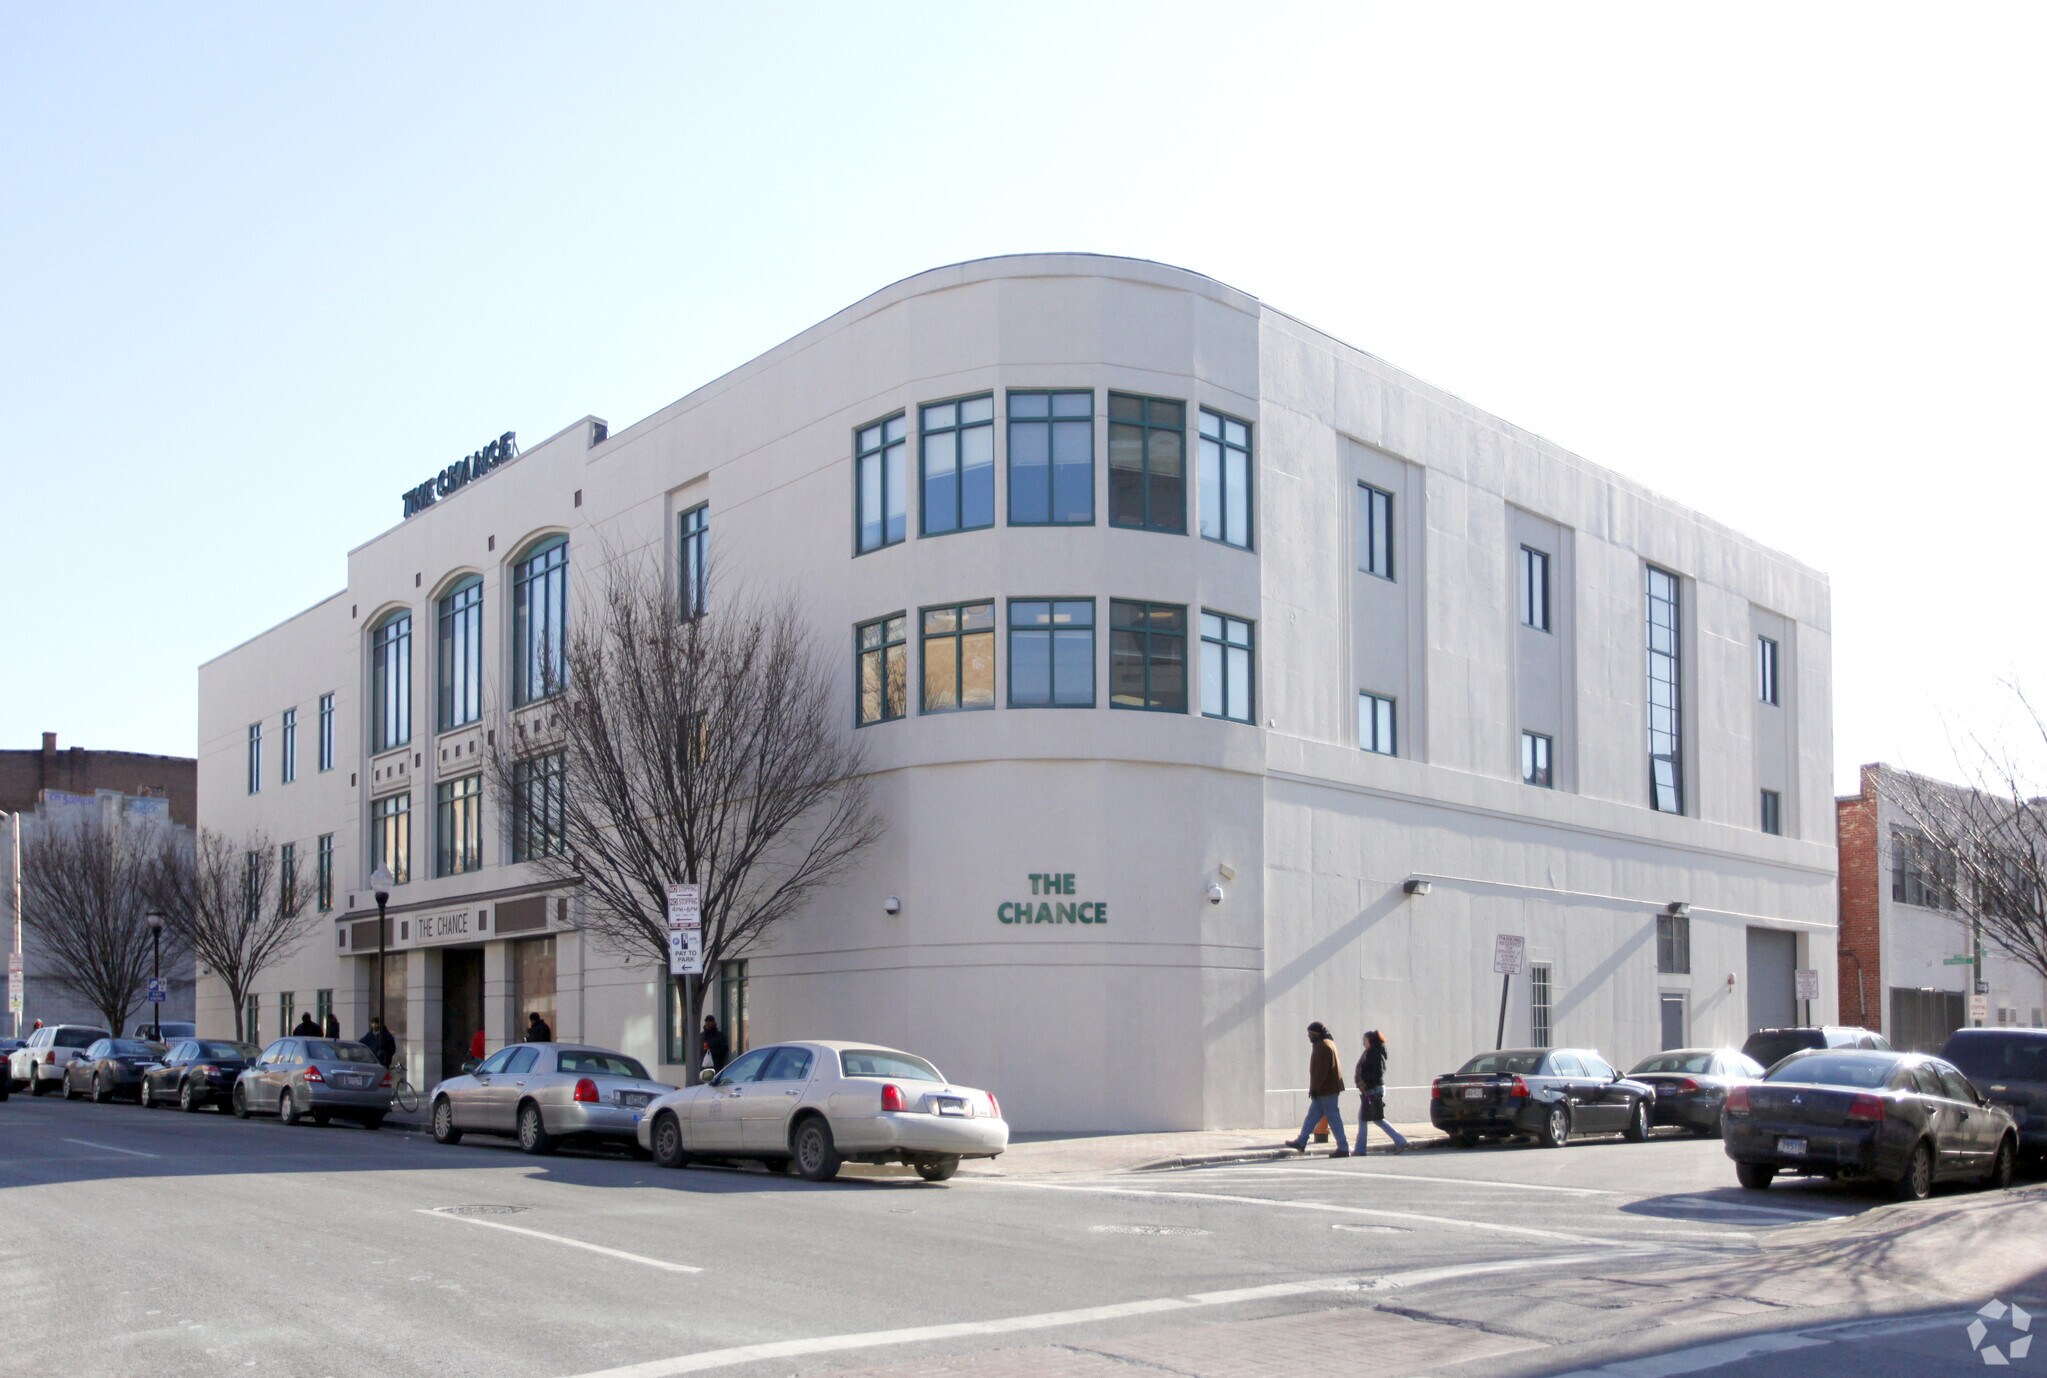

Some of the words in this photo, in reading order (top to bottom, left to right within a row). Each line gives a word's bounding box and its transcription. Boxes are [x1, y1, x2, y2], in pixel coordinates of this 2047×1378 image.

[402, 477, 437, 519] THE
[437, 431, 516, 497] CHANCE
[1028, 873, 1076, 895] THE
[997, 901, 1107, 924] CHANCE
[419, 918, 433, 938] THE
[438, 913, 468, 936] CHANCE
